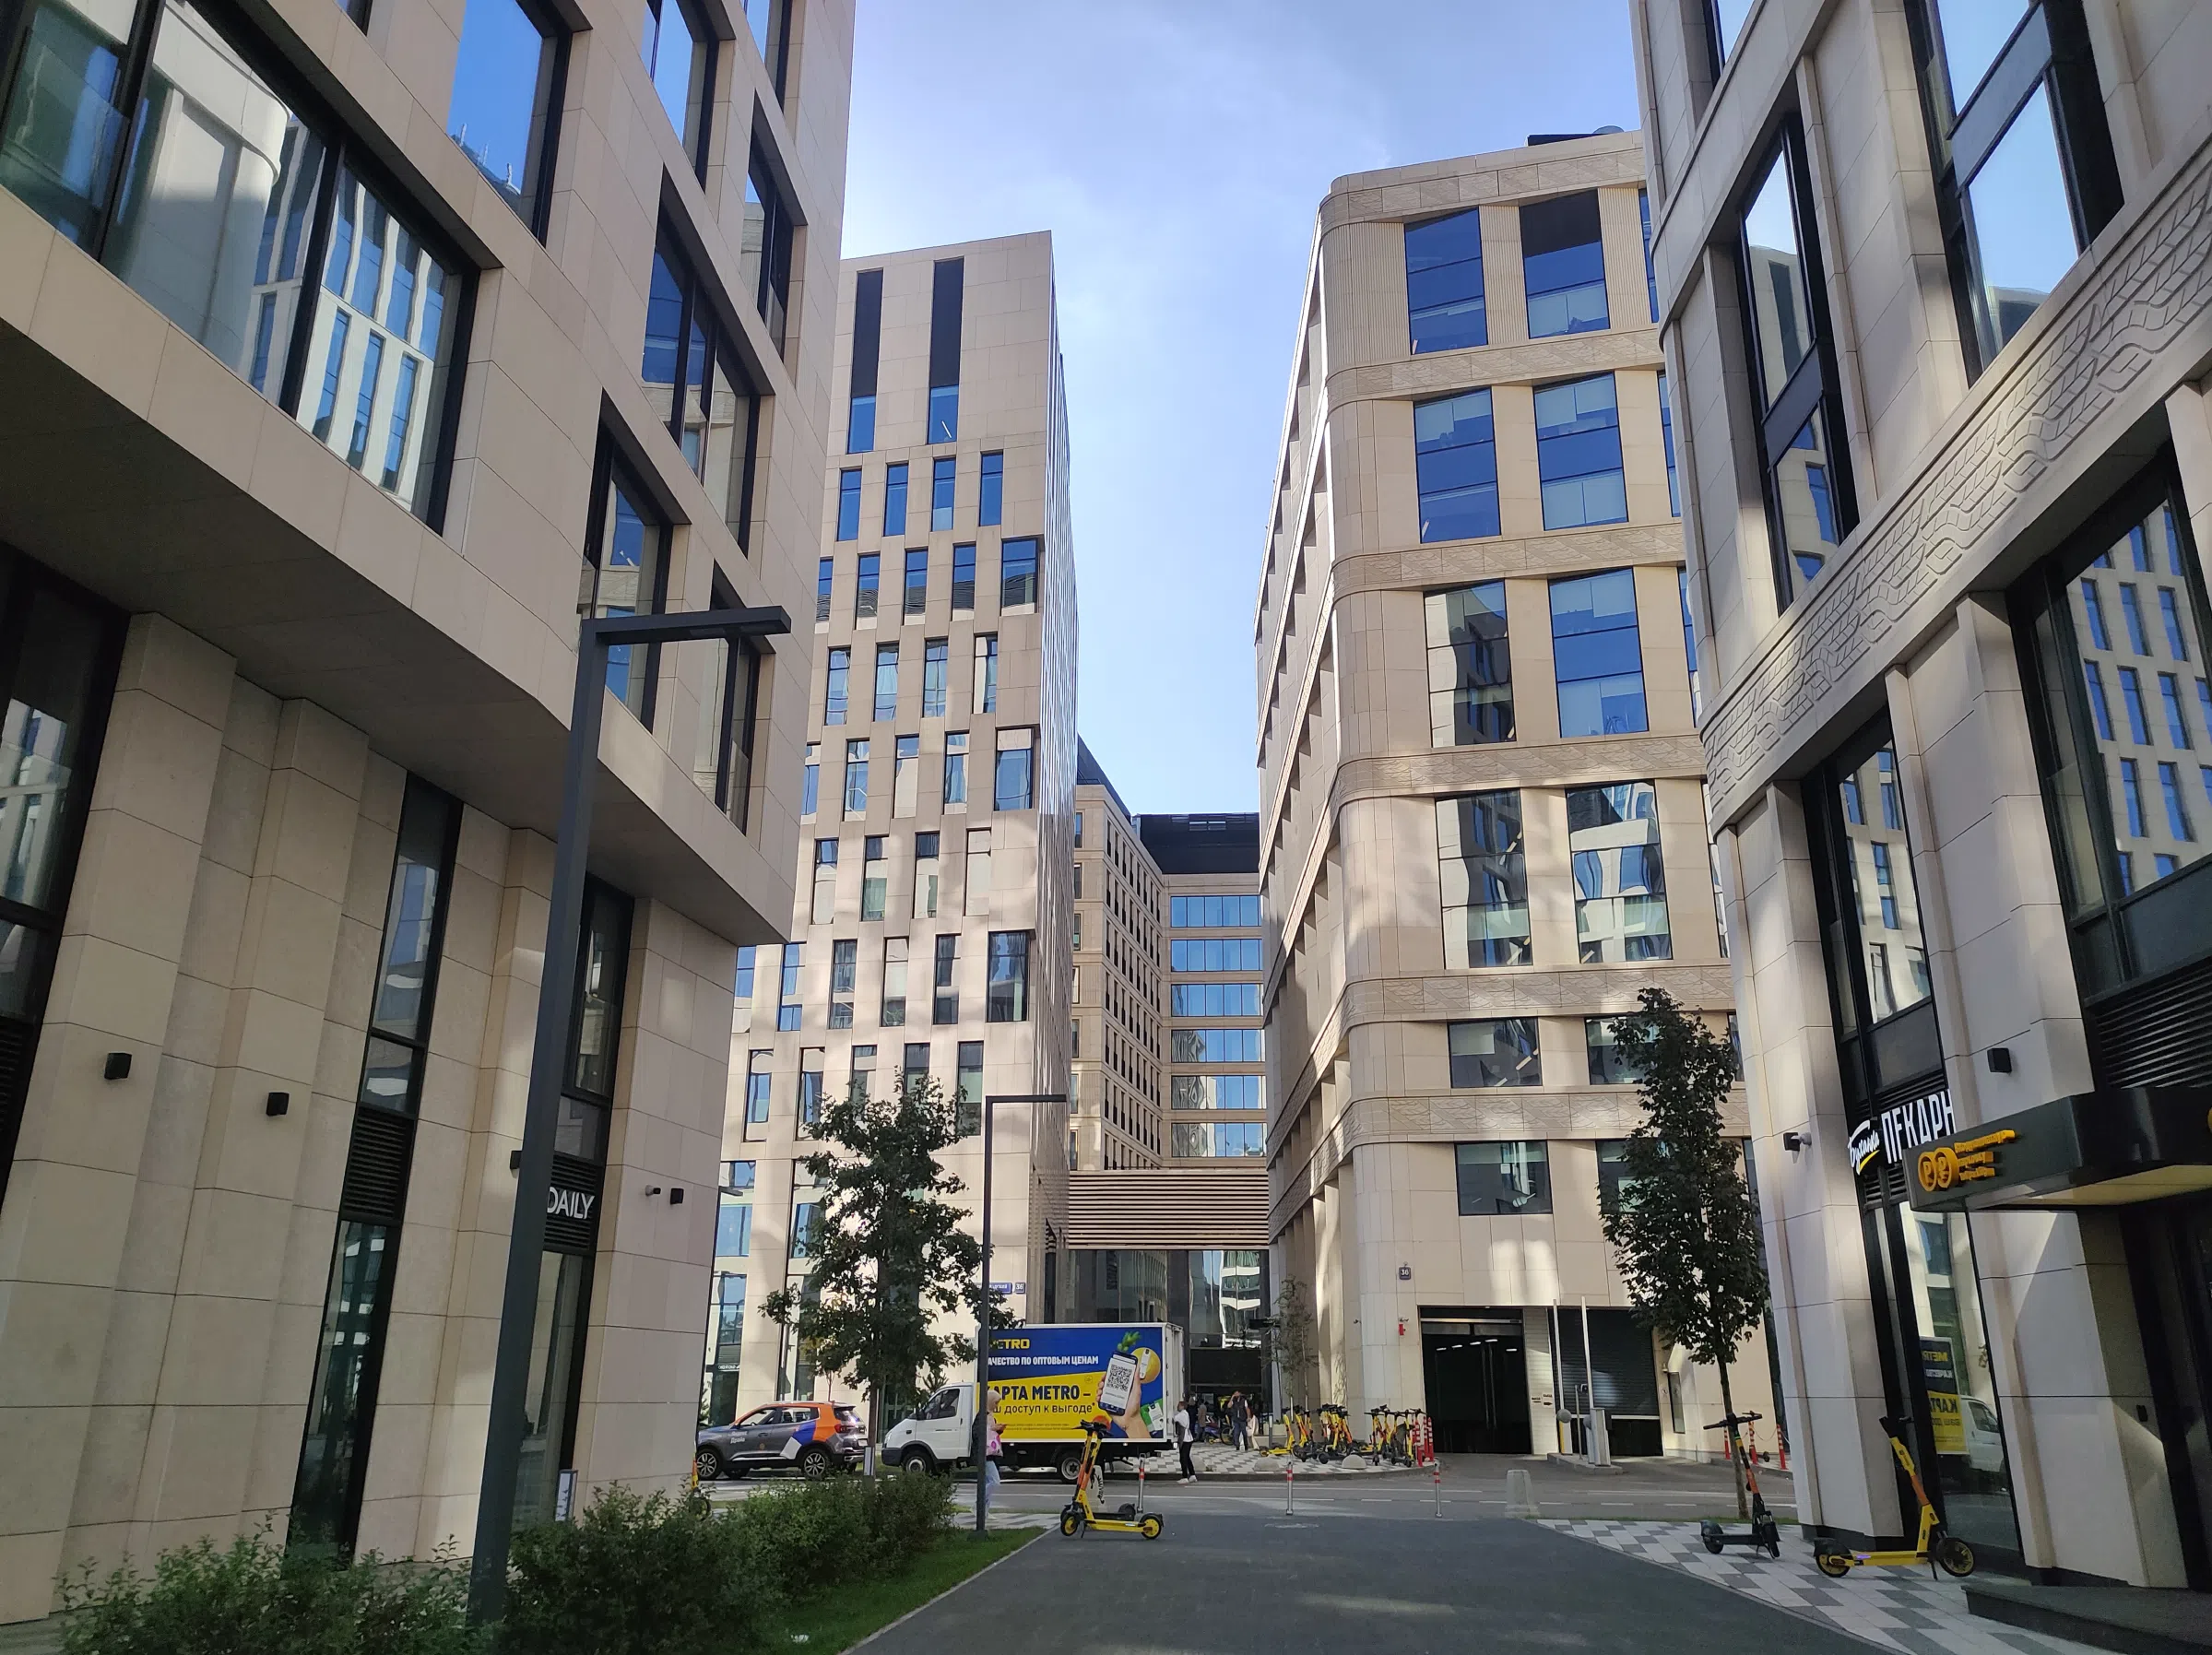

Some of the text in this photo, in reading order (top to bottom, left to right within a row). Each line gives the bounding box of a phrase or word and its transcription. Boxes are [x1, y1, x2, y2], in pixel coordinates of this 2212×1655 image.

[1881, 1089, 1957, 1164] ПЕКАРН
[547, 1187, 596, 1220] DAILY
[989, 1339, 1030, 1350] ETRO
[988, 1355, 1099, 1365] АЧЕСТВО ПО ОПТОВЫМ ЦЕНАМ
[988, 1386, 1028, 1401] РТА
[1032, 1385, 1080, 1401] METRO
[1004, 1404, 1041, 1415] доступ
